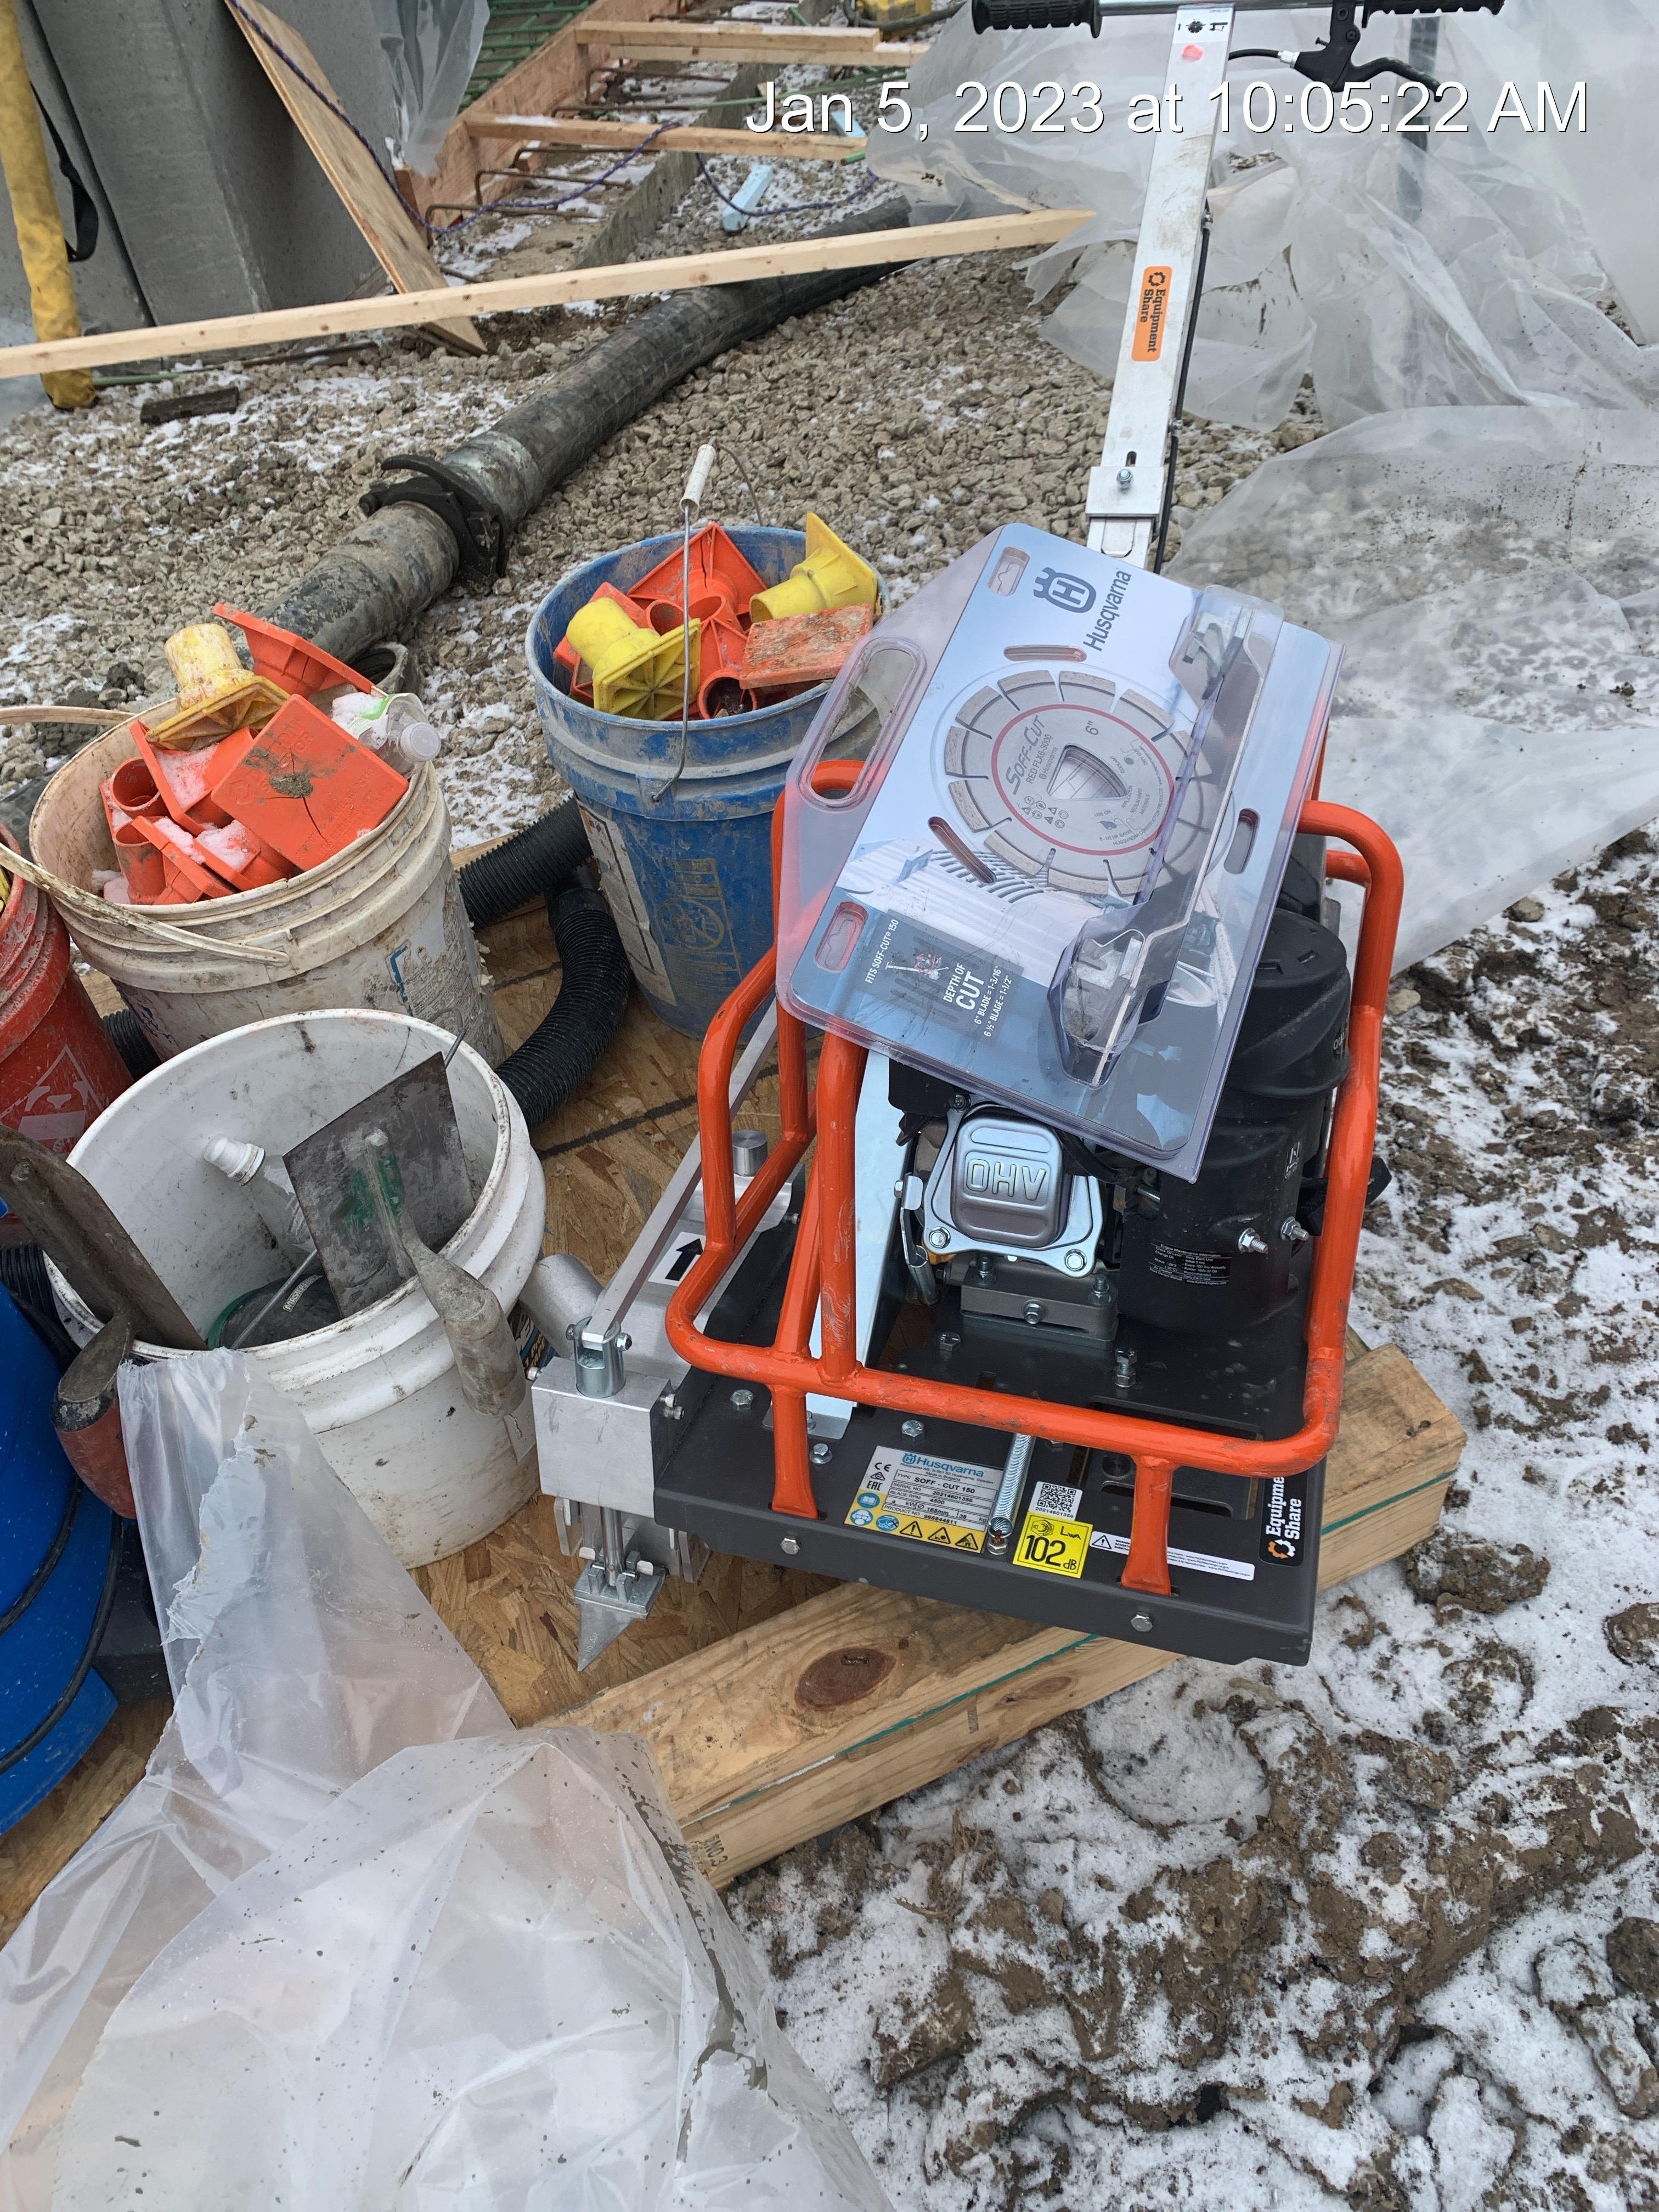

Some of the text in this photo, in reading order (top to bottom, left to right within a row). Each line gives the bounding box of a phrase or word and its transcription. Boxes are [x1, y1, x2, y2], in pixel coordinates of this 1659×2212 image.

[1139, 288, 1153, 324] Share
[1147, 288, 1167, 353] Equipment
[1083, 569, 1132, 652] Husqvarna
[1085, 721, 1099, 736] 6"
[1026, 734, 1052, 784] RED FLX6-3000
[1045, 747, 1058, 771] Husqvarna
[1110, 755, 1125, 774] COOLANT
[865, 969, 878, 984] FITS
[888, 919, 900, 932] 150
[943, 962, 967, 1003] DEPTH OF
[956, 970, 985, 1011] CUT
[977, 995, 991, 1017] BLADE
[990, 1000, 1003, 1022] BLADE
[965, 1158, 1048, 1203] OHV
[916, 1457, 984, 1477] Husqvarna
[893, 1482, 912, 1491] SERIAL
[933, 1491, 973, 1503] 20214601356
[914, 1477, 936, 1486] SOFF
[943, 1482, 960, 1491] CUT
[884, 1505, 911, 1514] PRODUCT
[1035, 1506, 1074, 1519] 20214601356
[1266, 1477, 1285, 1536] Equipme
[1284, 1498, 1302, 1540] Share
[1023, 1534, 1067, 1567] 102
[1063, 1558, 1078, 1571] dB
